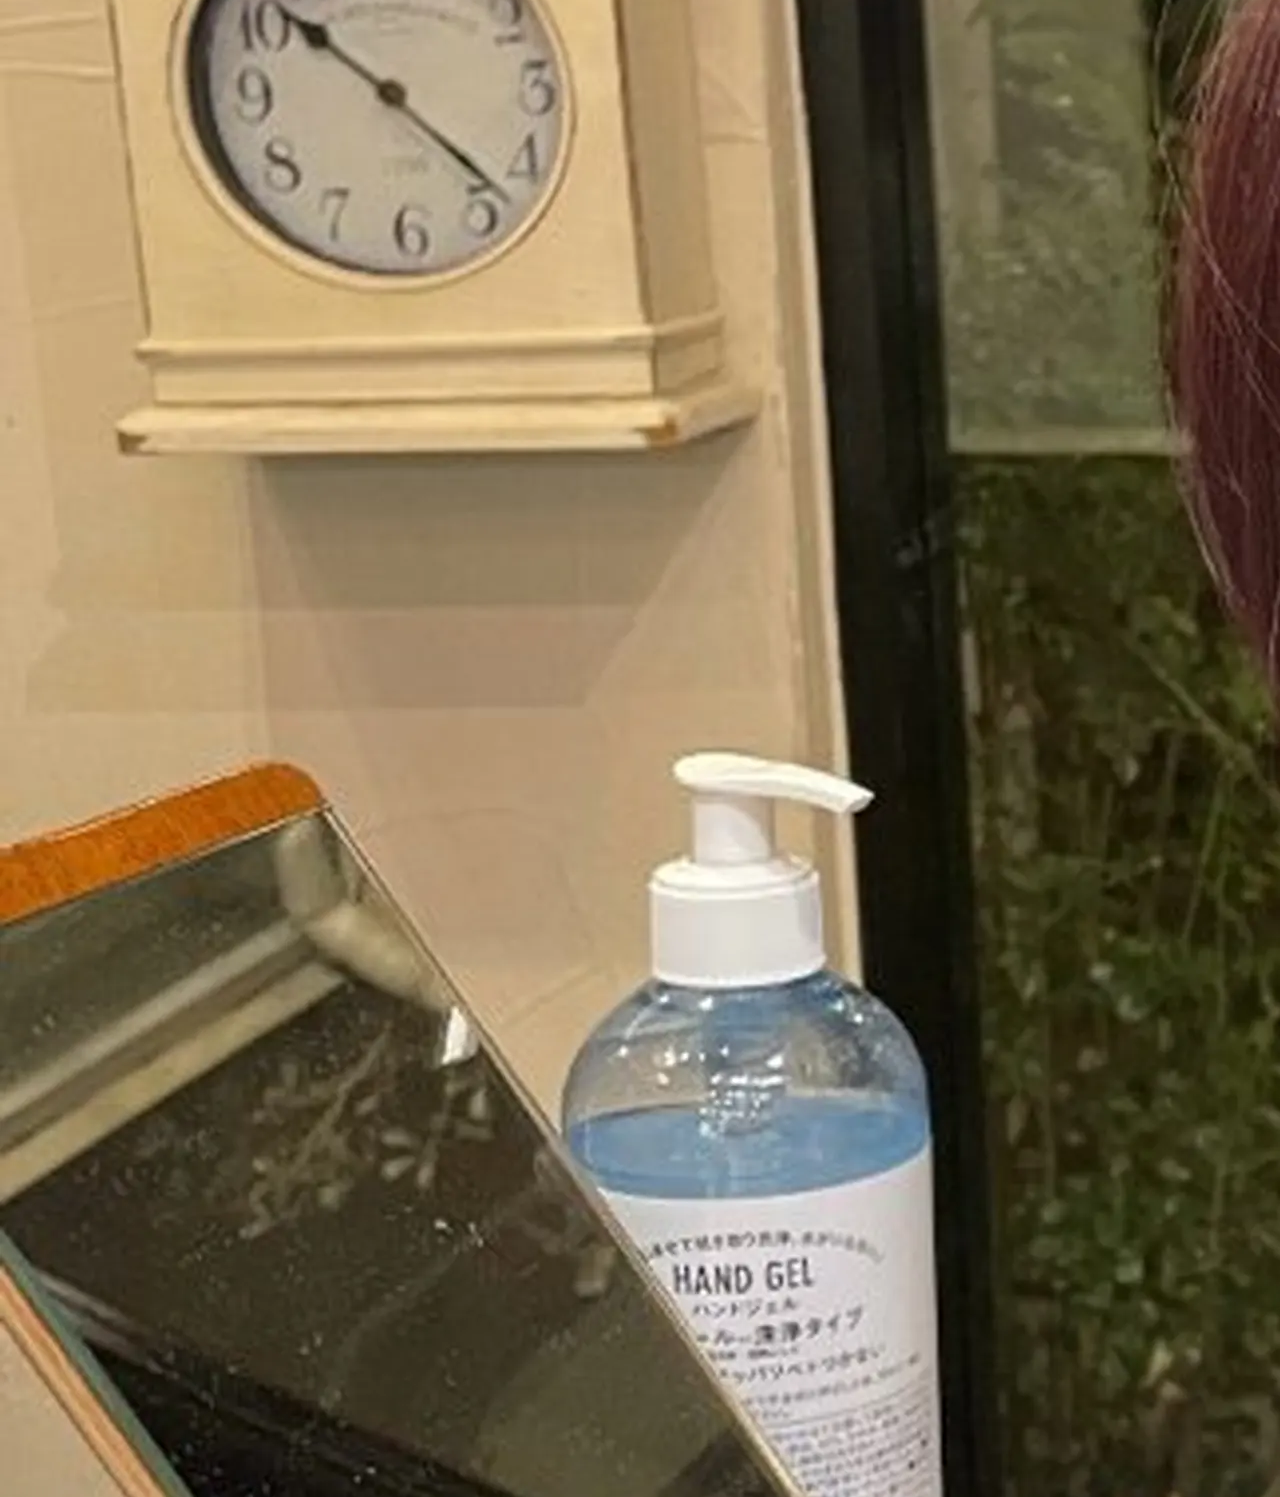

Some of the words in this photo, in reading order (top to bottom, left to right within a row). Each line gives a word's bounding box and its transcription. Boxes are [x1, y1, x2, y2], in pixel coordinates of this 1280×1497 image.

[235, 65, 273, 125] 9
[519, 59, 556, 117] 3
[263, 139, 303, 193] 8
[506, 132, 539, 183] 4
[319, 187, 351, 241] 7
[394, 205, 430, 257] 6
[673, 1264, 753, 1295] HAND
[765, 1257, 815, 1291] GEL
